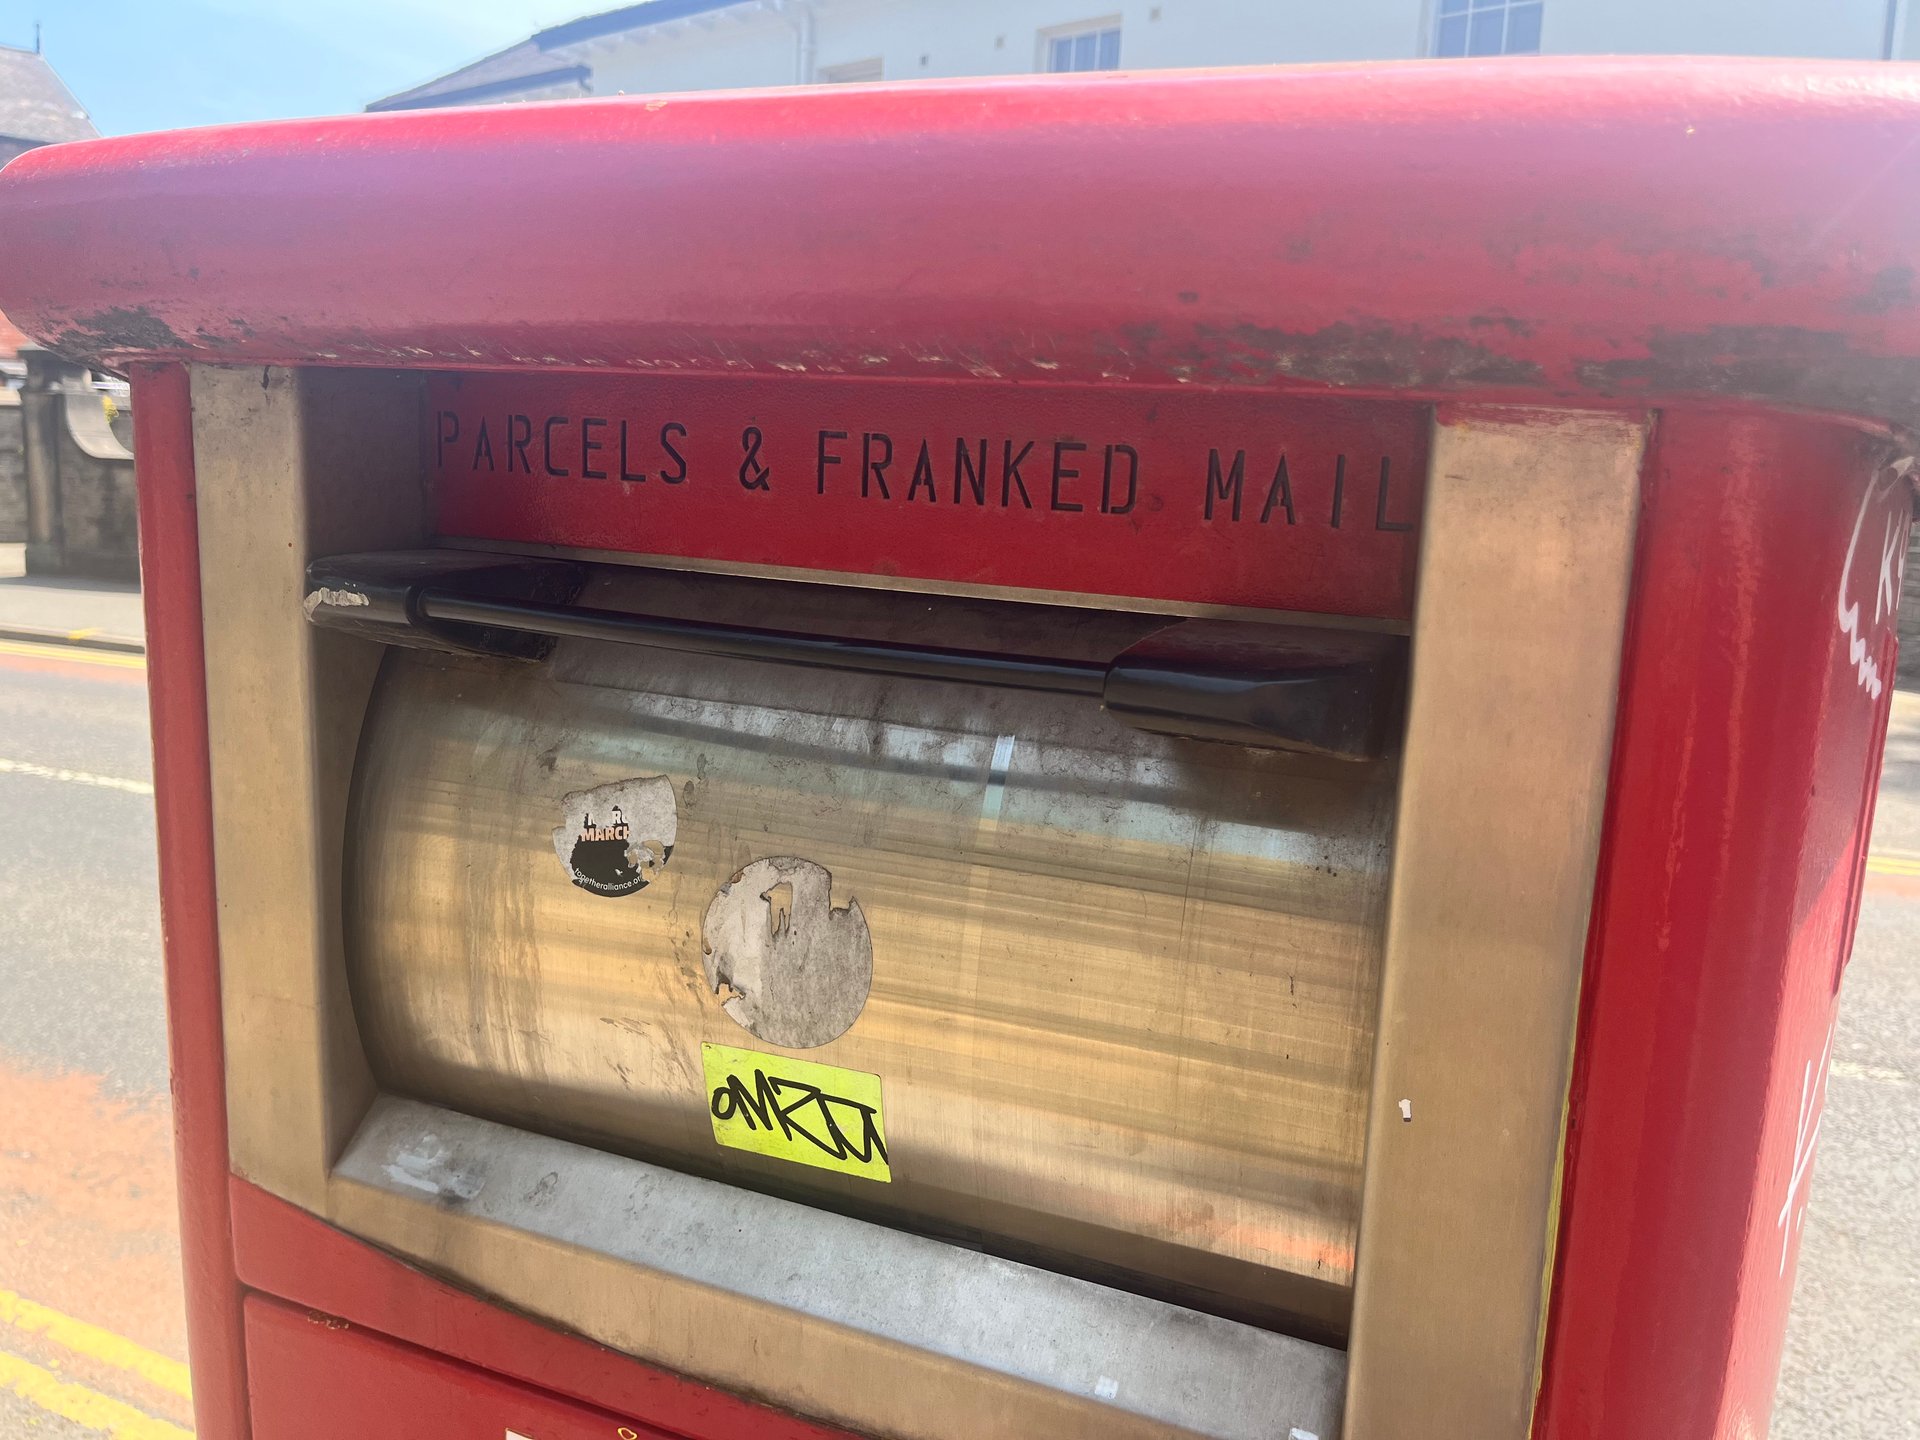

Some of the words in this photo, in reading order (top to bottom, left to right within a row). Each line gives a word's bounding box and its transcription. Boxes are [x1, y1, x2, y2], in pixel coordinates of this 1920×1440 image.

[436, 410, 687, 485] PARCELS
[738, 426, 770, 492] &
[816, 430, 1140, 516] FRANKED
[1203, 448, 1414, 532] MAIL
